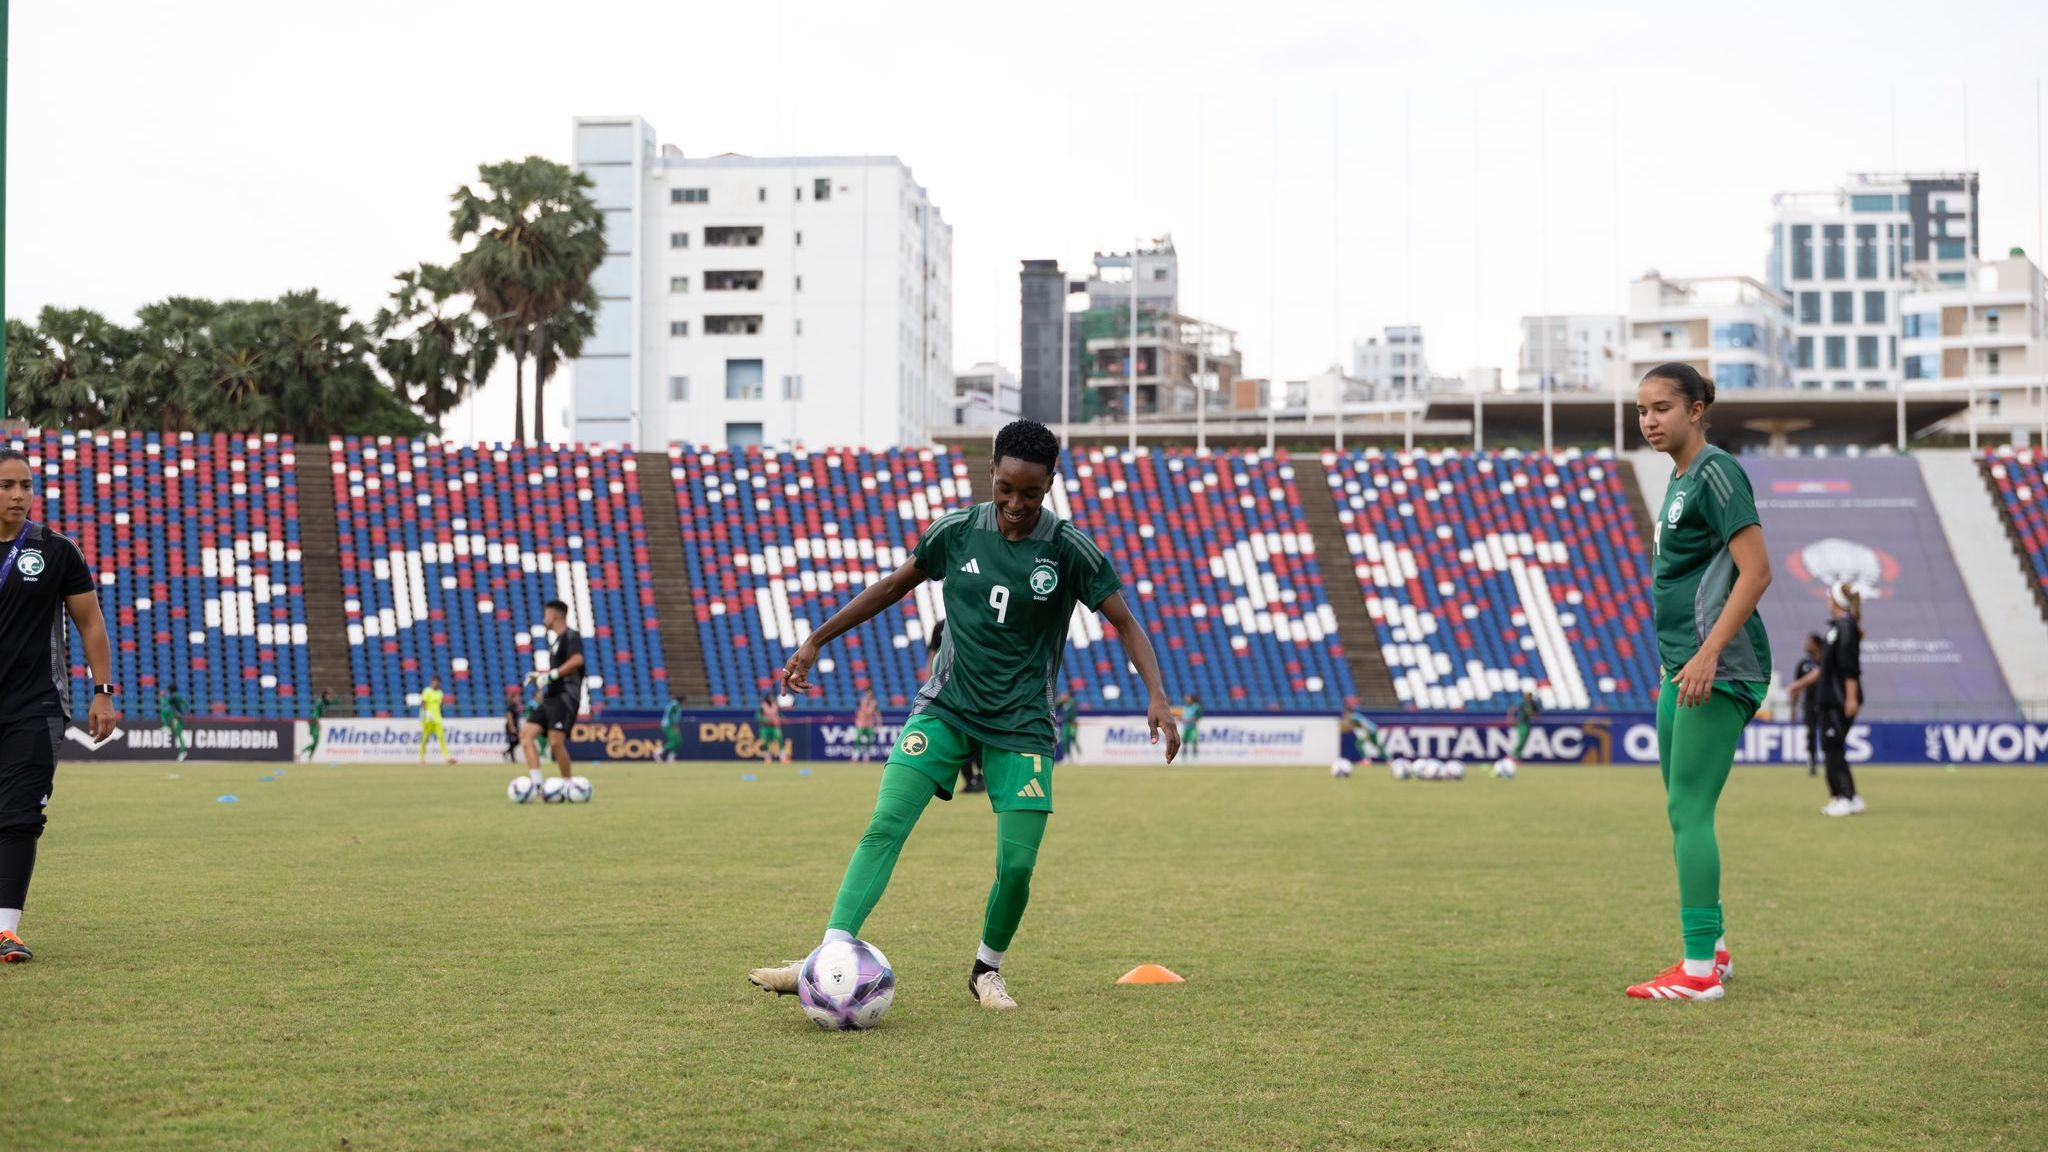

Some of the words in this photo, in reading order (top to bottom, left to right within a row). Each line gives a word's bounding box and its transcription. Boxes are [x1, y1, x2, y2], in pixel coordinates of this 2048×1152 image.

[989, 584, 1010, 624] 9
[128, 729, 172, 748] MADE
[195, 729, 278, 749] CAMBODIA
[571, 724, 624, 742] DRA
[700, 723, 753, 741] DRA
[1353, 727, 1583, 759] VATTANAC
